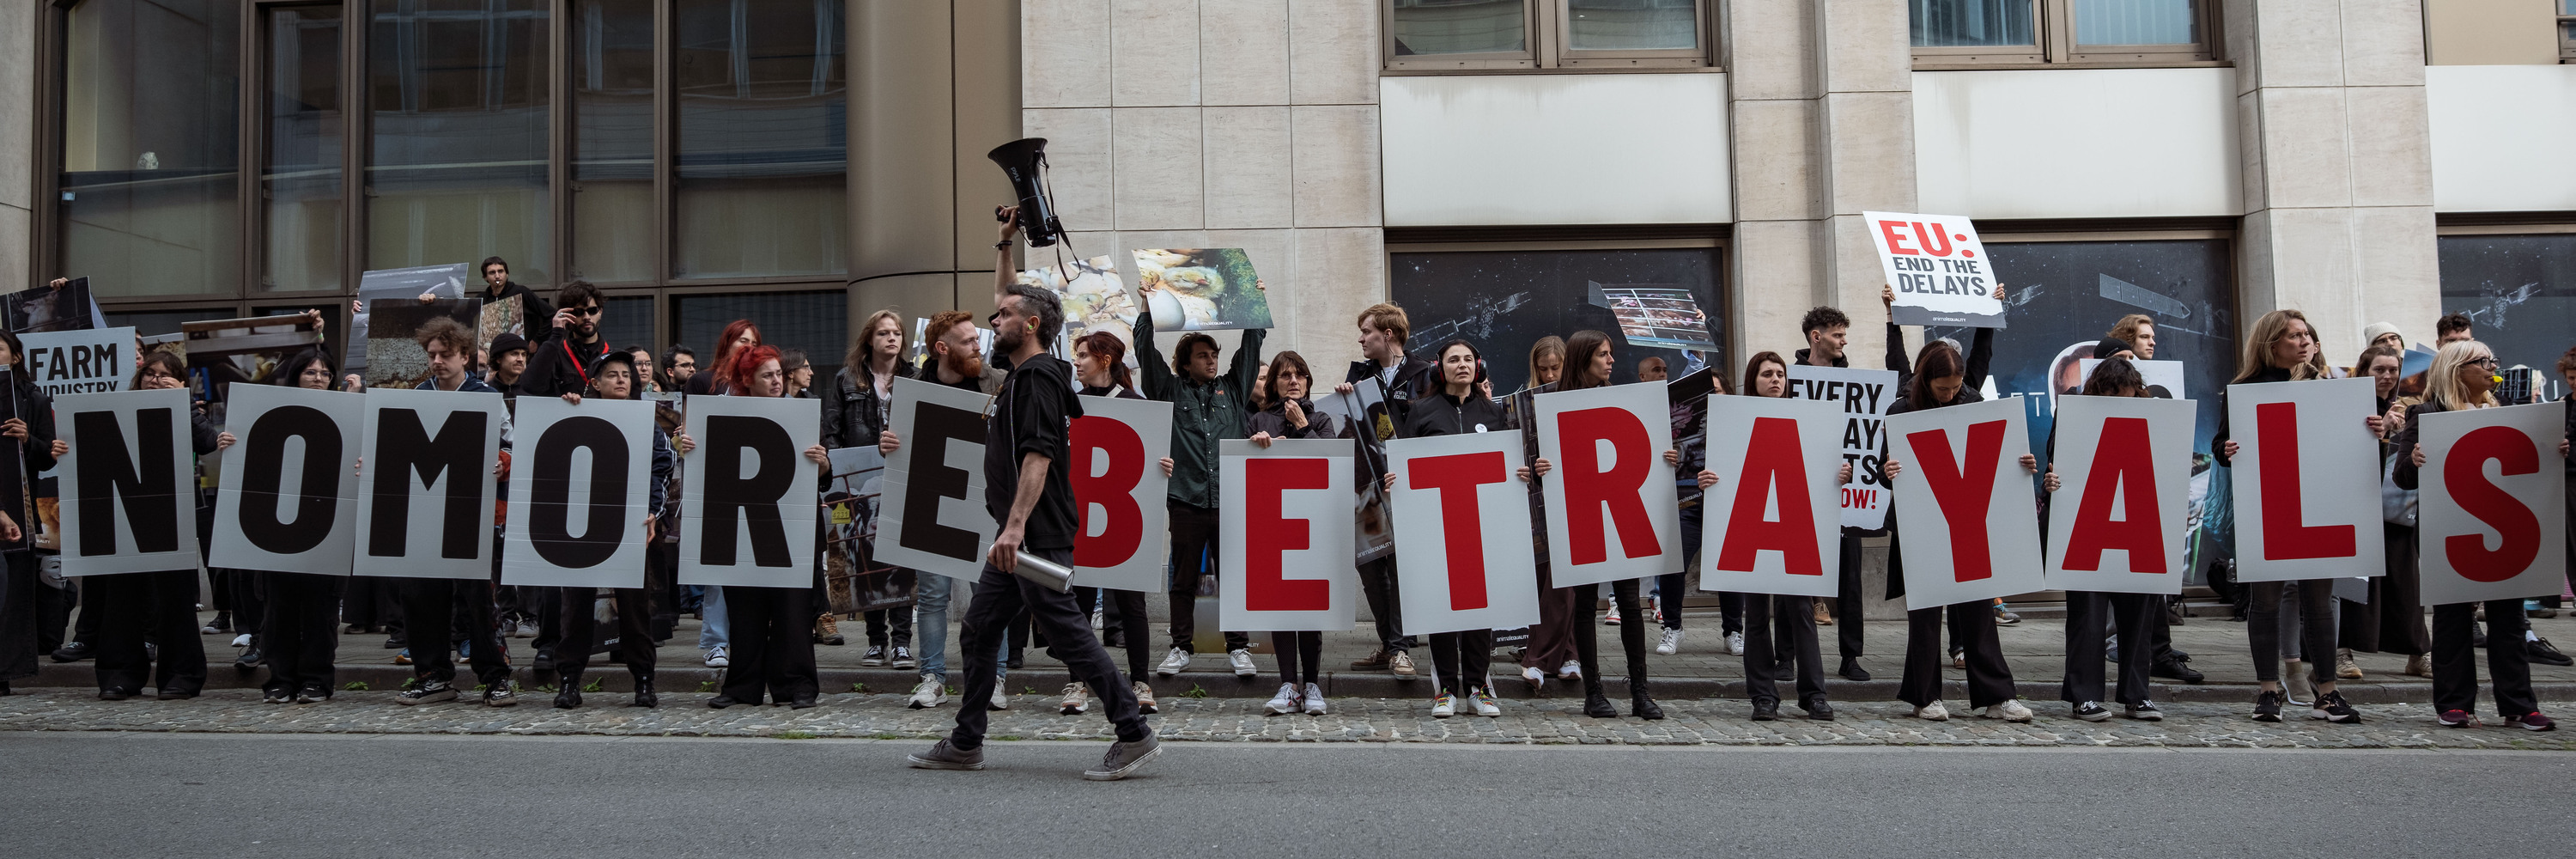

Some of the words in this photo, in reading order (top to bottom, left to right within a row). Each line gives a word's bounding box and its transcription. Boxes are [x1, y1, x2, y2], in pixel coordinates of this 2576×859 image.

[1878, 220, 1975, 258] EU:
[1893, 257, 1935, 271] END
[1939, 259, 1982, 274] THE
[1898, 273, 1987, 296] DELAYS
[29, 343, 118, 381] FARM
[74, 408, 178, 557] N
[239, 405, 342, 554] O
[368, 408, 487, 559] M
[529, 417, 629, 568] O
[701, 416, 795, 567] R
[900, 400, 986, 562] E
[1068, 415, 1145, 568] B
[1246, 459, 1329, 611] E
[1357, 540, 1393, 558] animalEQUALITY
[1407, 451, 1507, 611] T
[1558, 407, 1662, 565] R
[1717, 417, 1822, 576] A
[1906, 419, 2007, 582] Y
[2062, 417, 2167, 573] A
[2257, 402, 2356, 560] L
[2443, 425, 2540, 582] S
